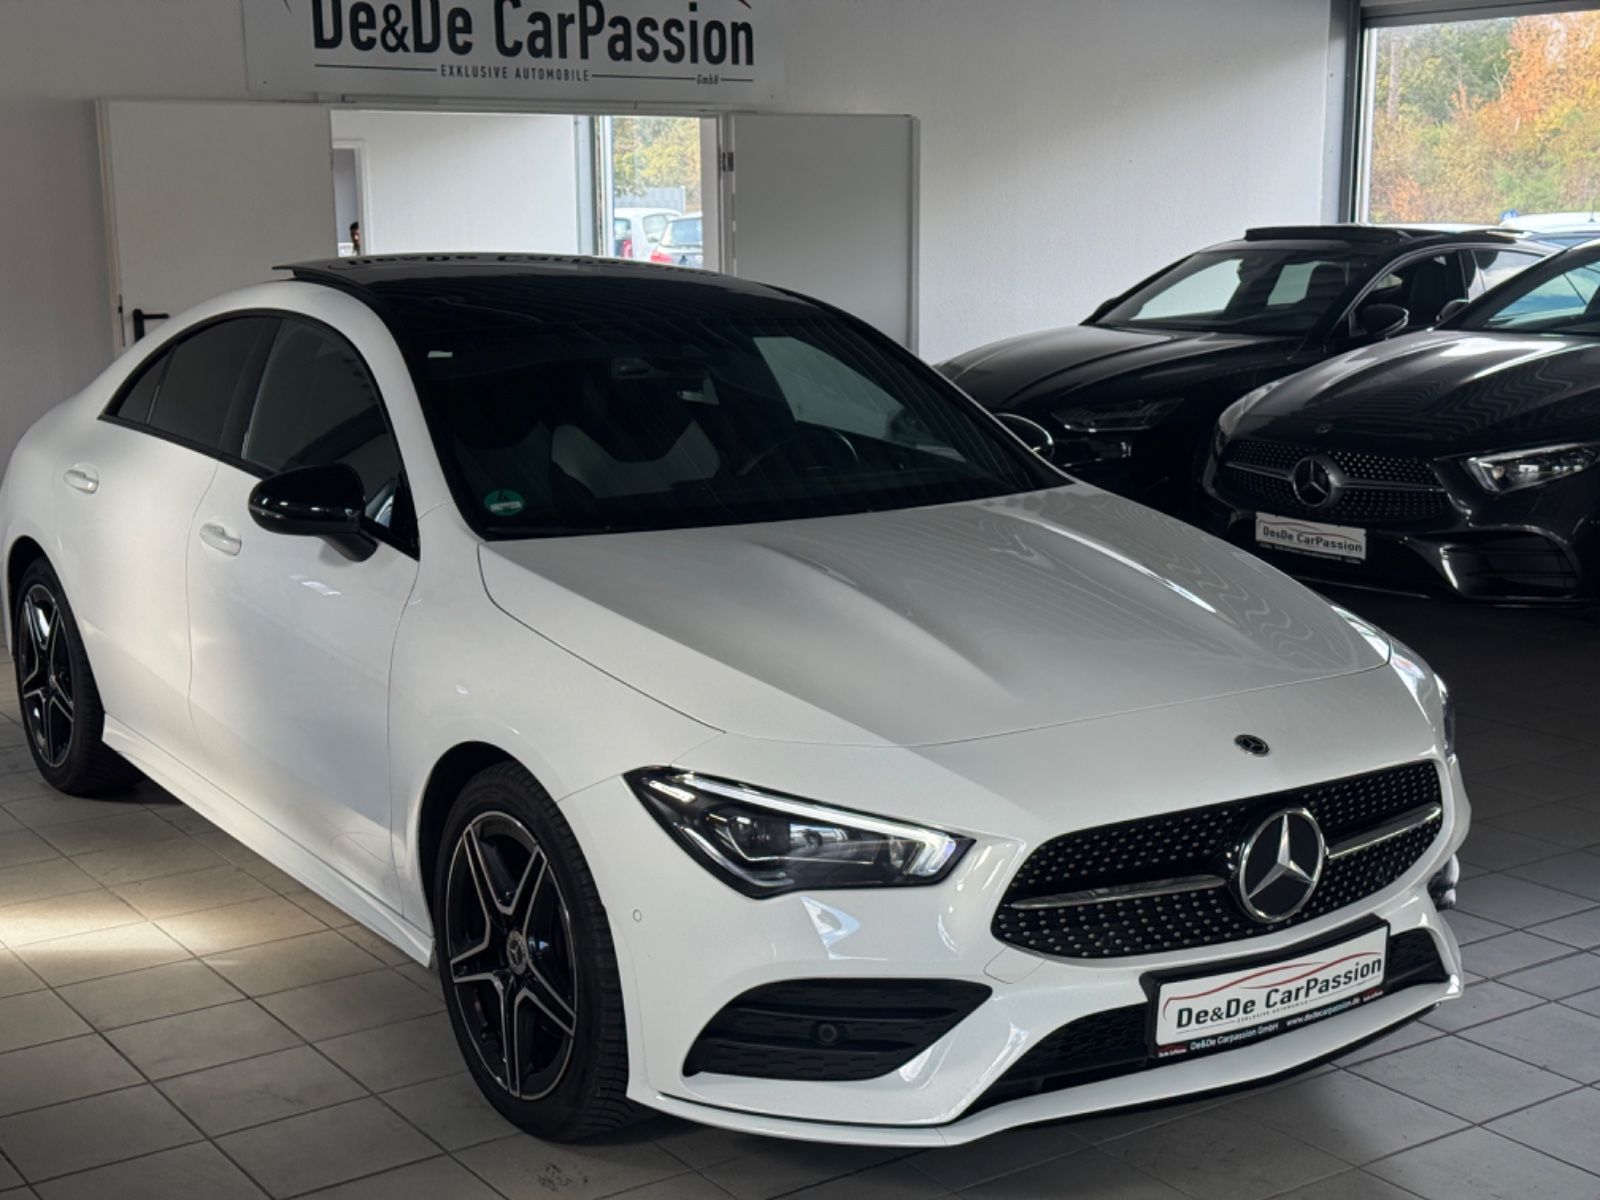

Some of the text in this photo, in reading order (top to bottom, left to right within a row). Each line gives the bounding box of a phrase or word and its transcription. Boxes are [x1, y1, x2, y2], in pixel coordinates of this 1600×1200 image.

[312, 0, 754, 66] De&De CarPassion
[440, 64, 590, 82] EXKLUSIVE AUTOMOBILE
[1297, 533, 1363, 552] CarPassion
[1176, 958, 1382, 1029] De&De CarPassion
